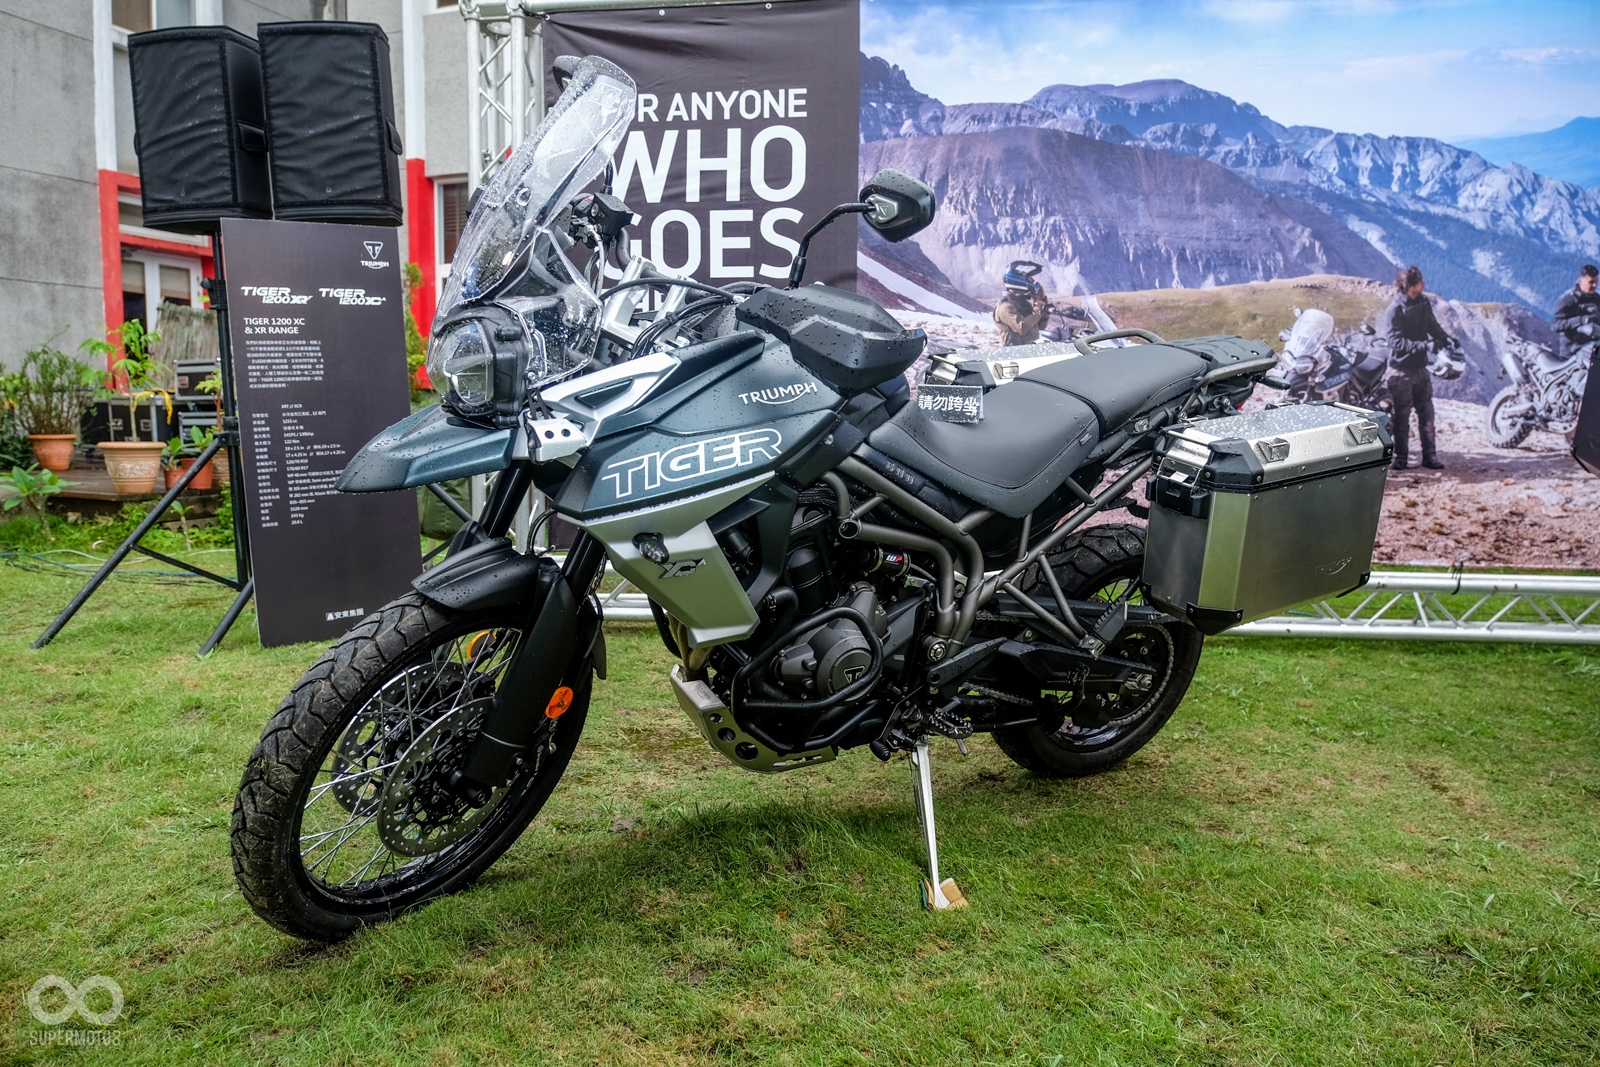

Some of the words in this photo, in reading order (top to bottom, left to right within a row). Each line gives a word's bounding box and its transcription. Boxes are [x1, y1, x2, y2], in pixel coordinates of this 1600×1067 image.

[666, 88, 807, 121] ANYONE
[611, 125, 806, 203] WHO
[240, 286, 291, 296] TIGER
[319, 288, 365, 297] TIGER
[243, 317, 270, 325] TIGER
[271, 317, 292, 325] 1200
[293, 317, 305, 325] XC
[244, 326, 253, 334] &
[254, 326, 267, 334] XR
[268, 326, 299, 334] RANGE
[738, 381, 818, 405] TRIUMPH
[601, 428, 783, 499] TIGER
